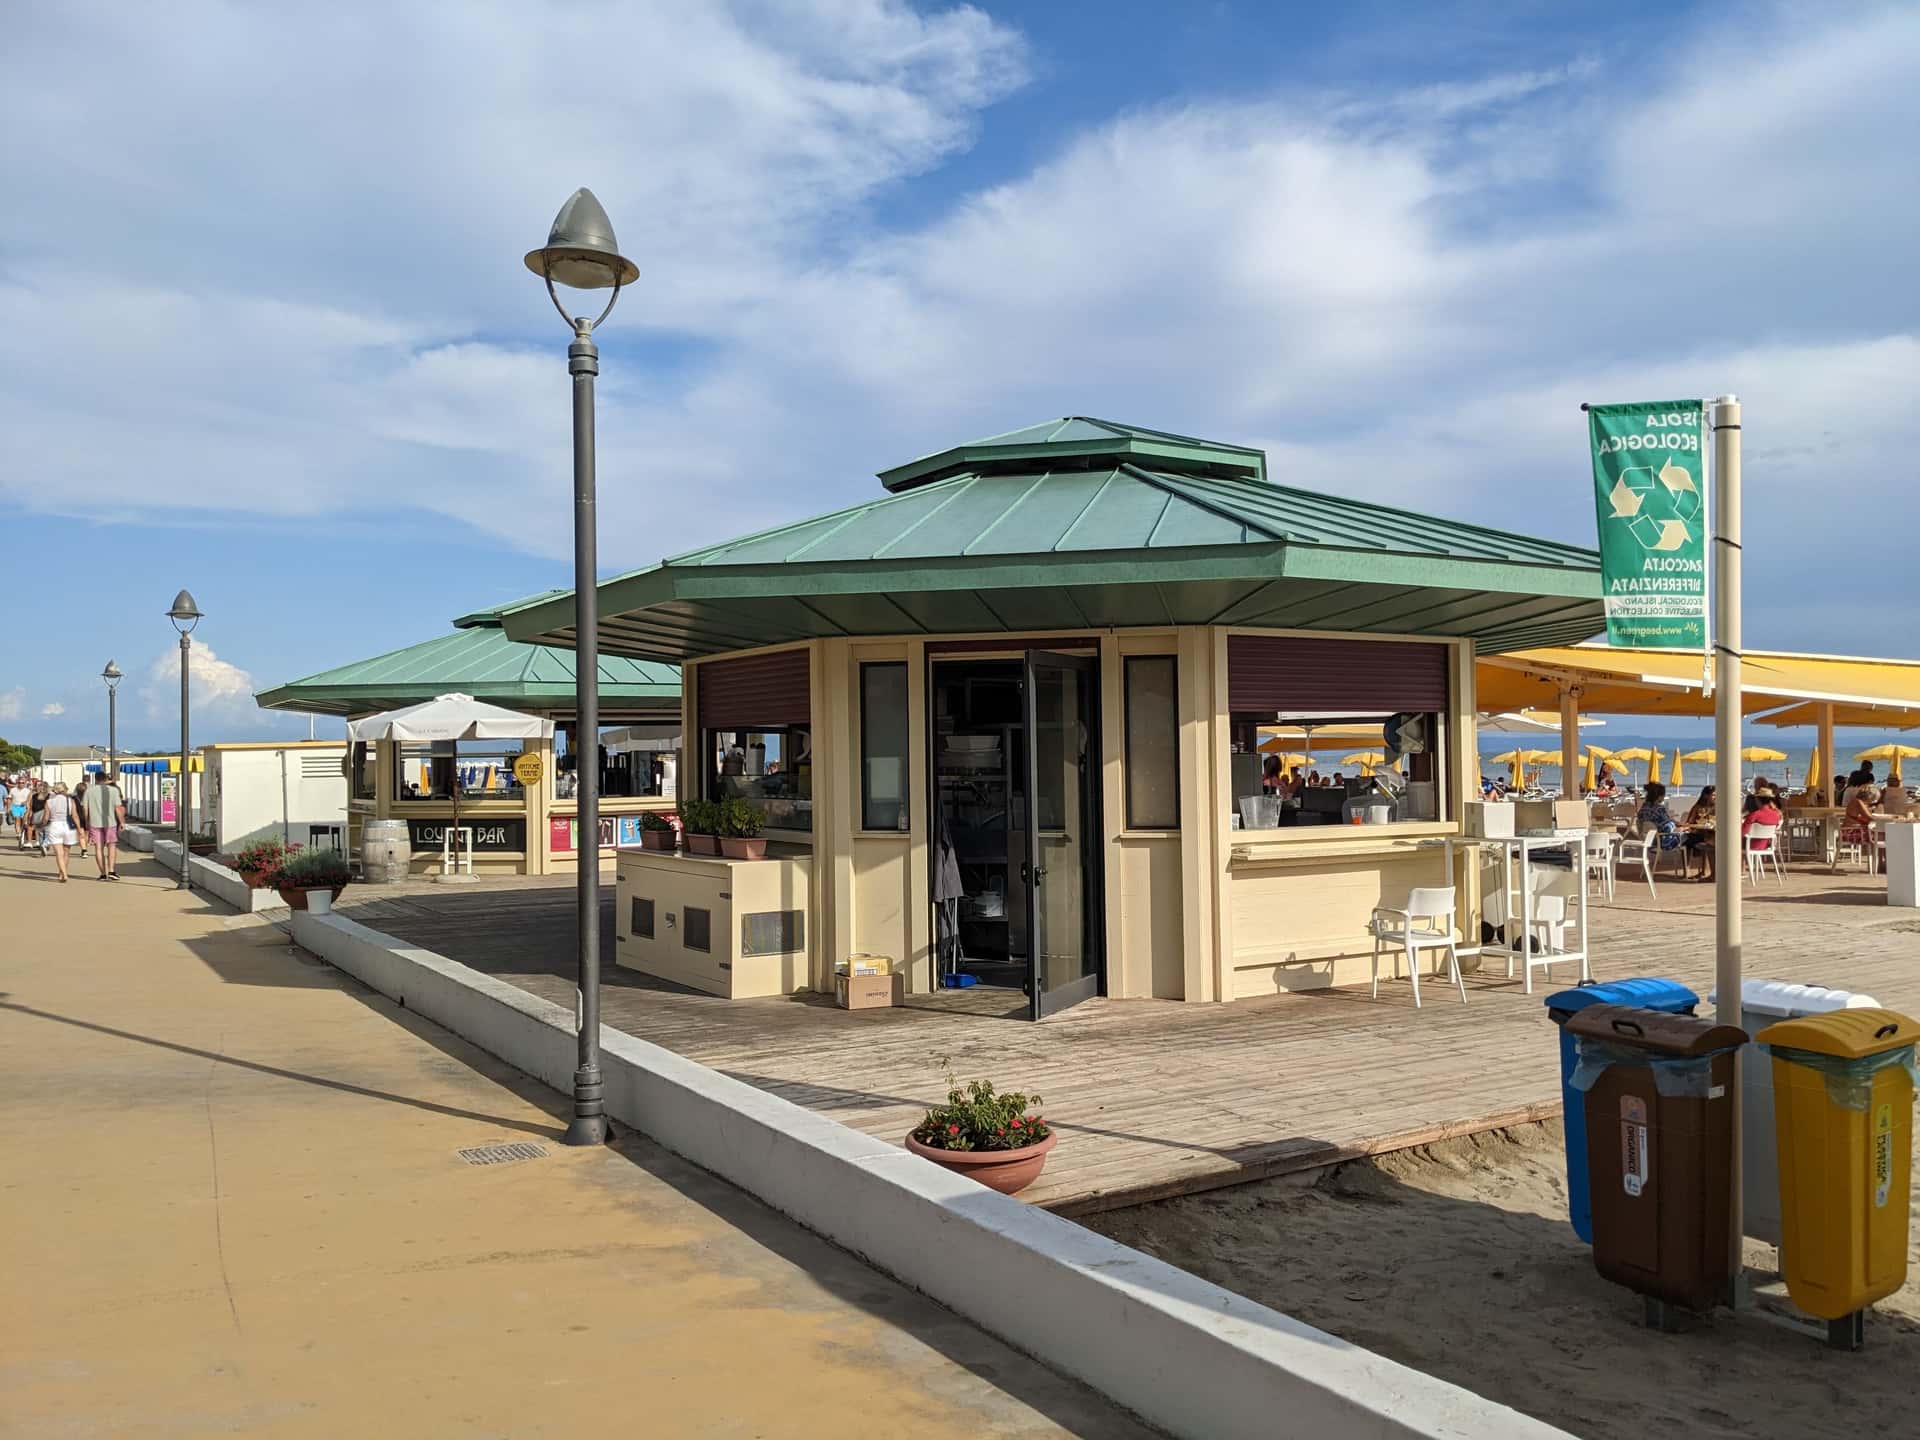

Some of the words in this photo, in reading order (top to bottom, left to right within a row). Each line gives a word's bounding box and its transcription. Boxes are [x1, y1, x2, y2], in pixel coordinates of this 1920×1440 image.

[416, 827, 472, 843] LOU
[477, 826, 506, 844] BAR
[1627, 1125, 1636, 1173] ORGANICO
